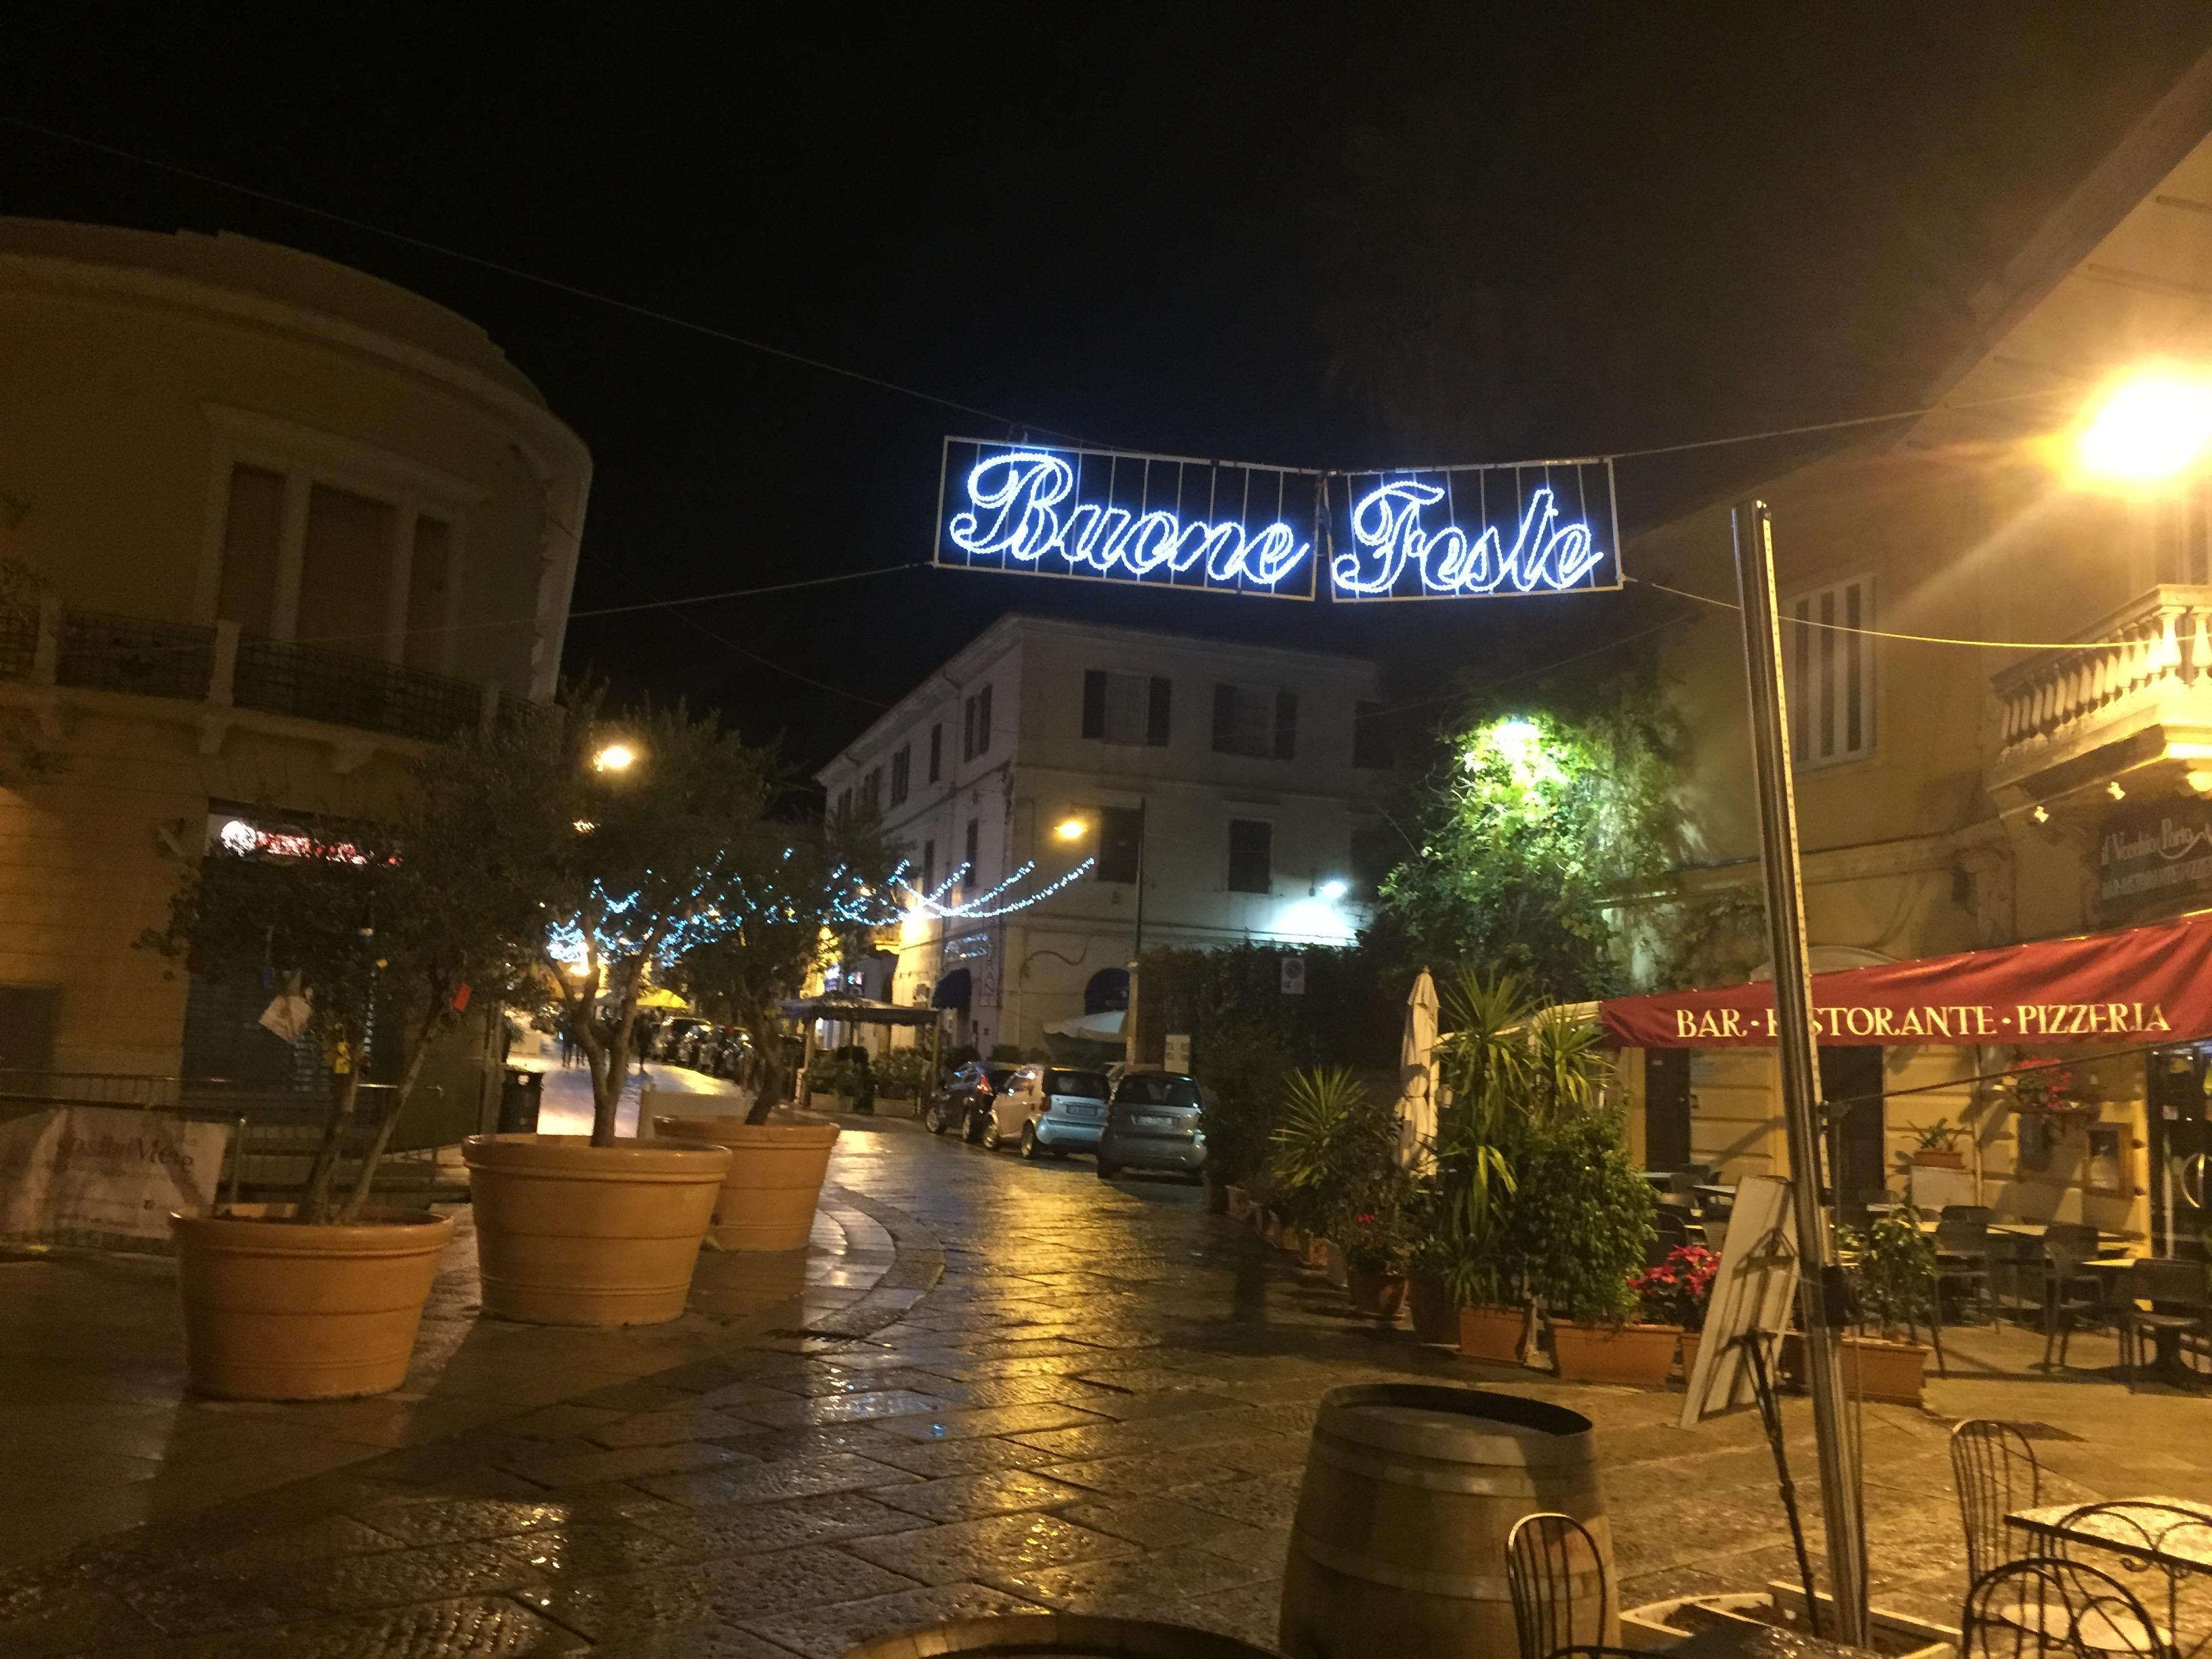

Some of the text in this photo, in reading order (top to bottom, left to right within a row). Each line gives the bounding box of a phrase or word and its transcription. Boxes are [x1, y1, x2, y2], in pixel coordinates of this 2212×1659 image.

[950, 452, 1604, 594] Buone Feste
[1676, 1008, 1748, 1038] BAR
[2015, 1002, 2172, 1035] PIZZERIA
